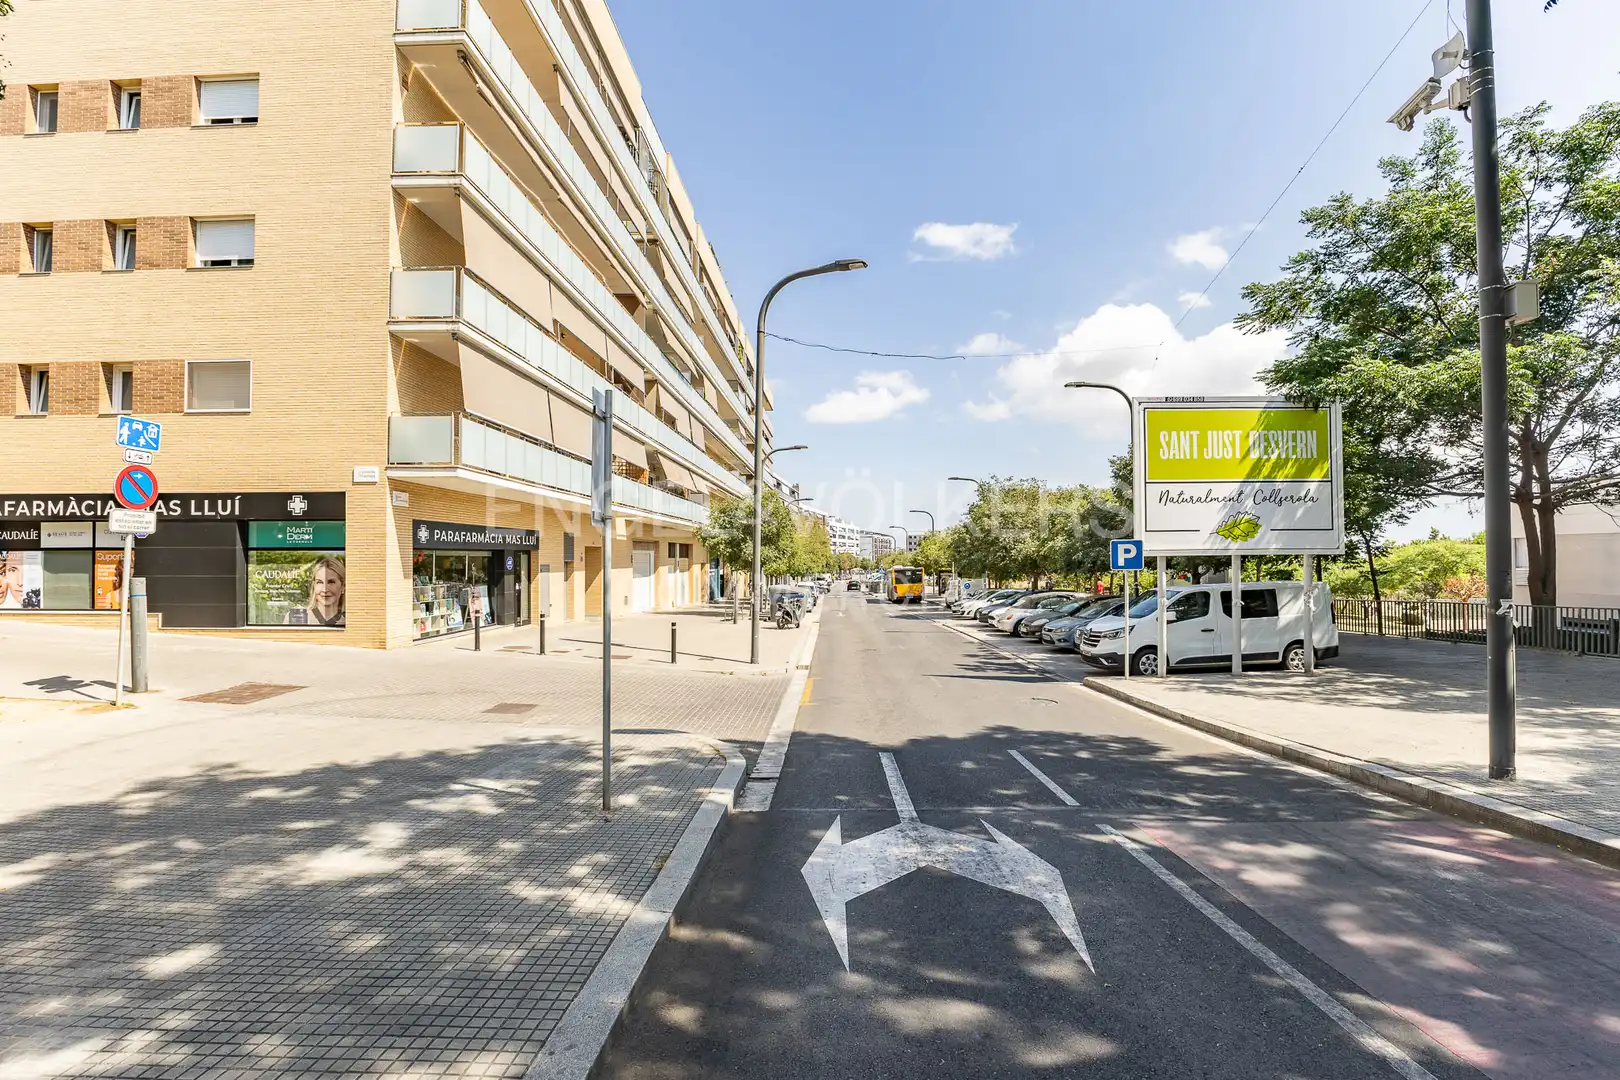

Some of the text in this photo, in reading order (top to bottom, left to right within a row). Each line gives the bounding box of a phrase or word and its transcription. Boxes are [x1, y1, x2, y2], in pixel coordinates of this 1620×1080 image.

[1159, 430, 1317, 459] SANT JUST DESVERN
[0, 495, 242, 516] FARMÀCIA AS LLUÍ
[1158, 488, 1319, 506] Naturalment Collserola
[434, 529, 537, 545] PARAFARMÀCIA MAS LLUÍ
[1117, 543, 1137, 566] P
